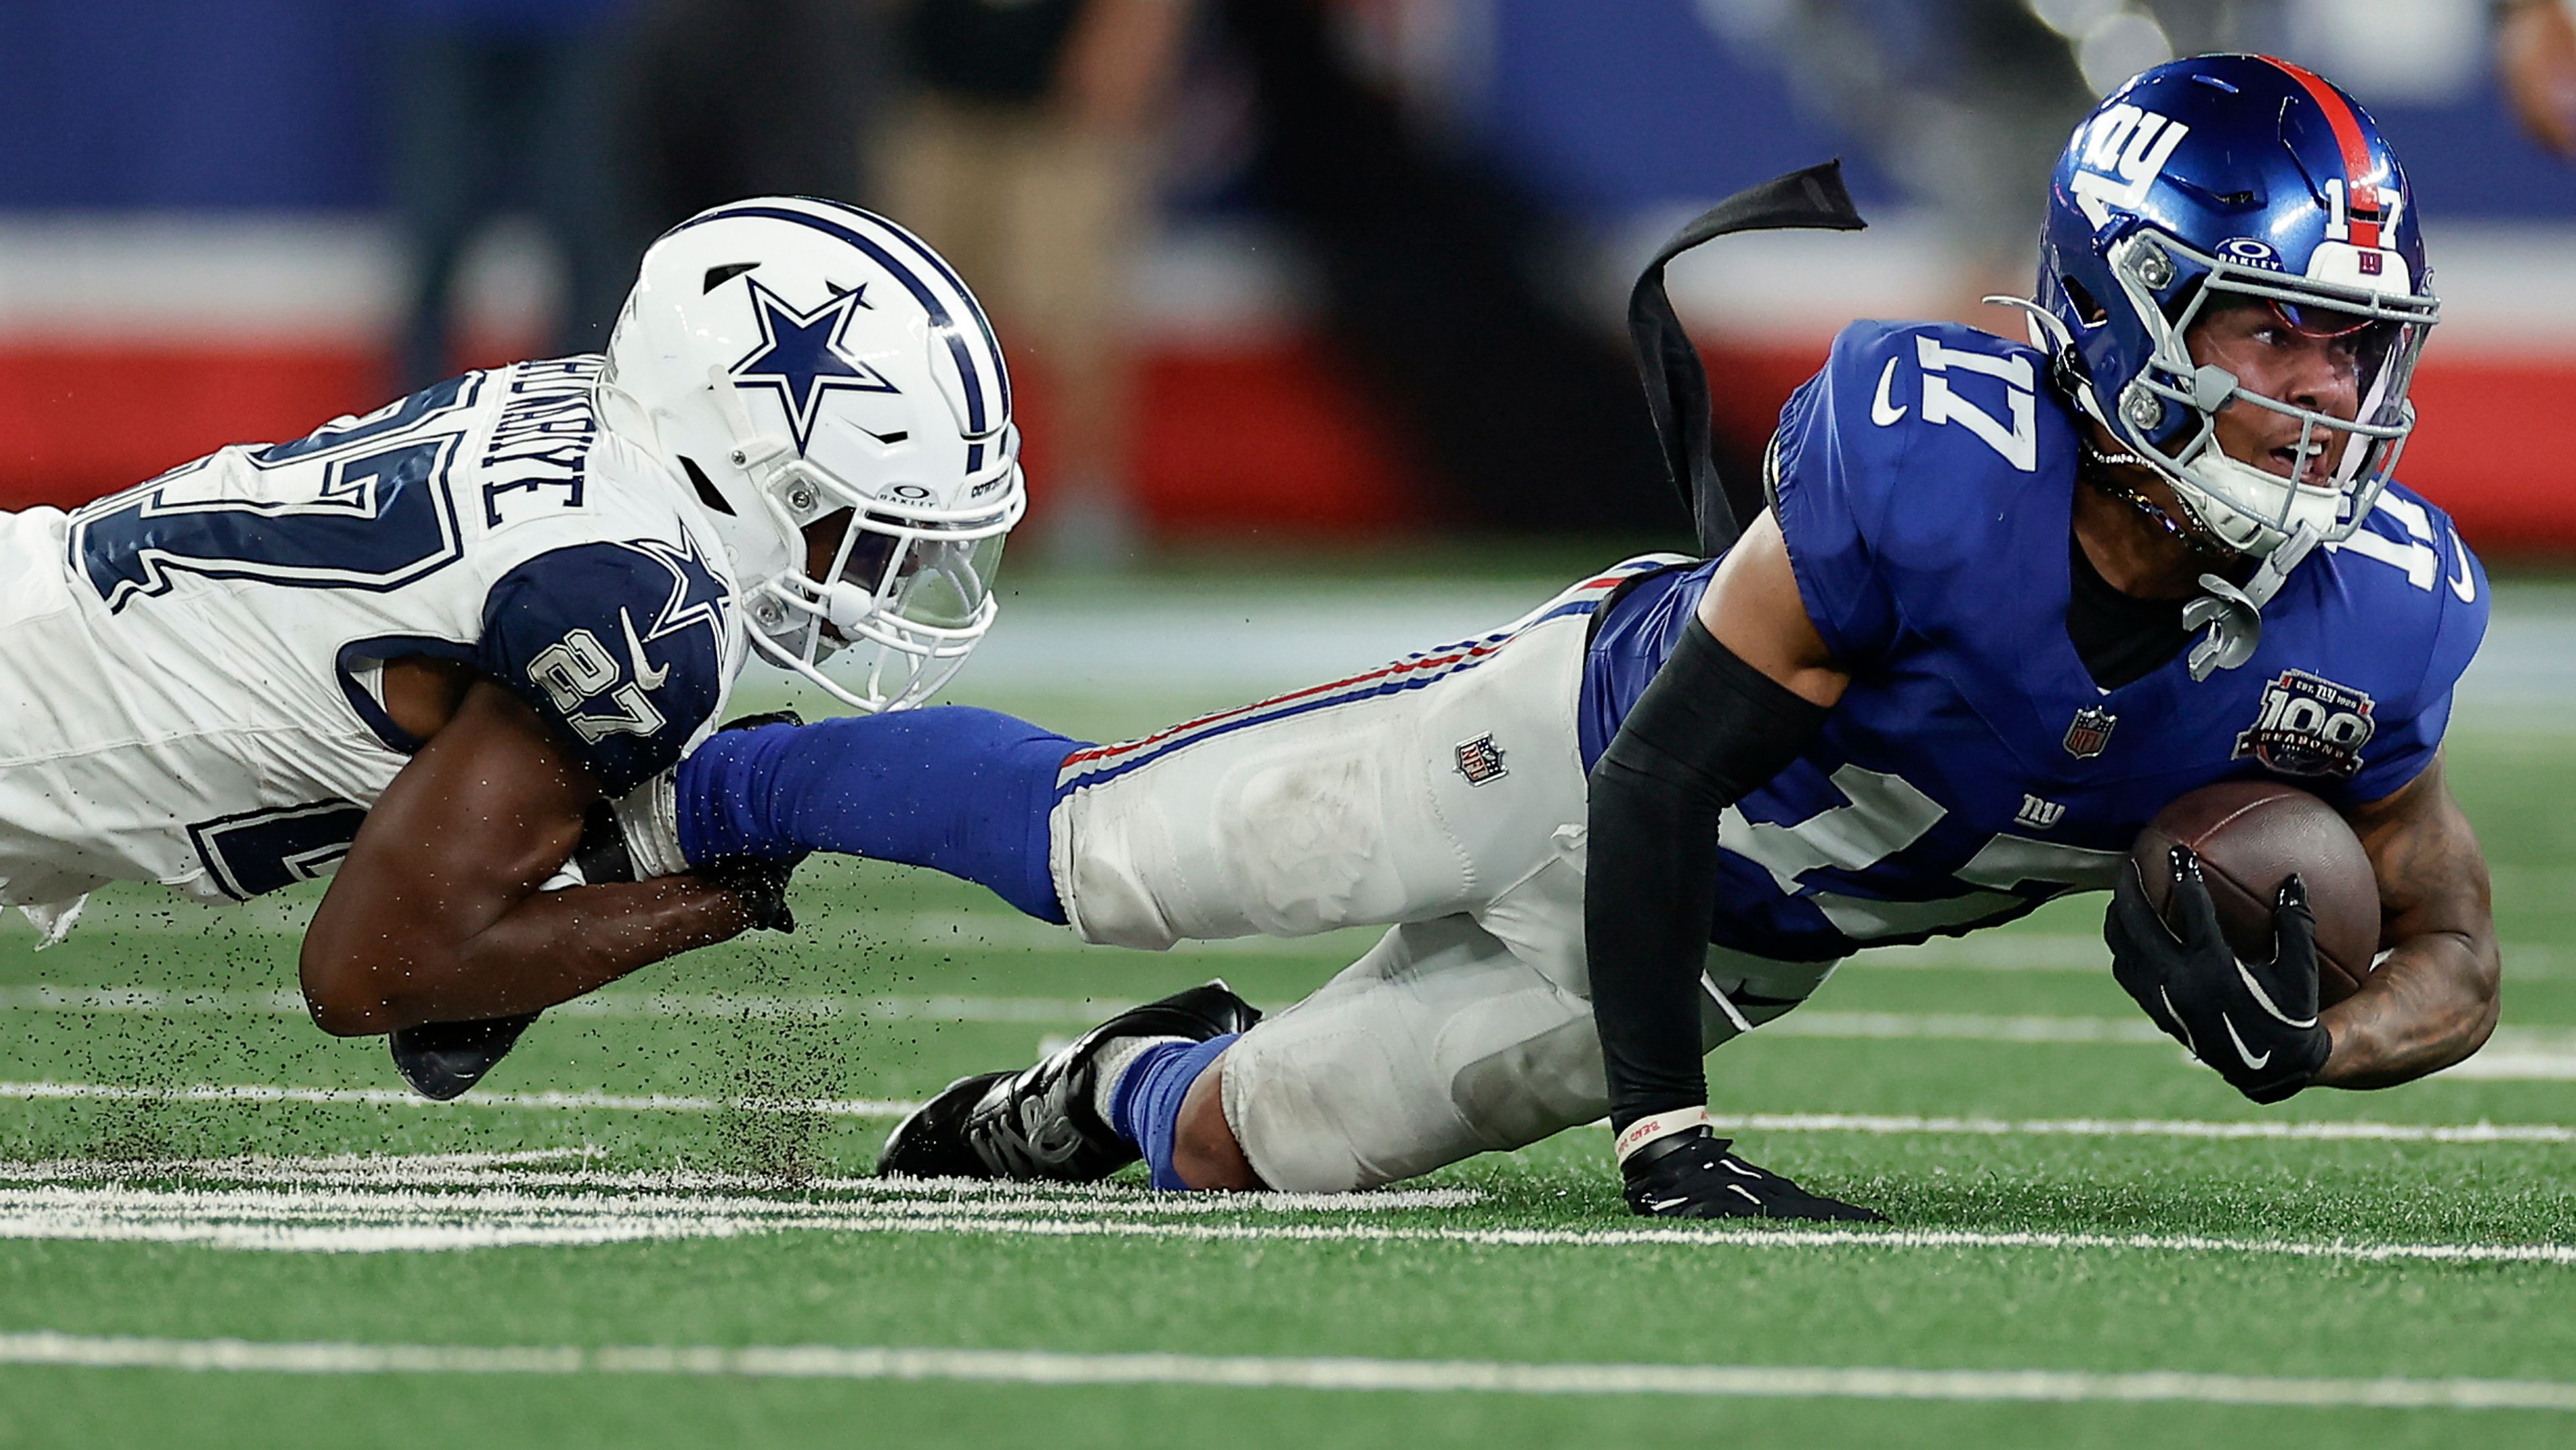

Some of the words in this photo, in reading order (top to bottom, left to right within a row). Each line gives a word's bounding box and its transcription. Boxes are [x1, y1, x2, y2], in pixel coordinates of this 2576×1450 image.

[2325, 178, 2402, 249] 17
[2218, 253, 2279, 270] OAKLEY
[1917, 335, 2036, 471] 17
[879, 494, 934, 508] OAKLEY
[527, 628, 667, 745] 27
[2260, 689, 2367, 745] 100
